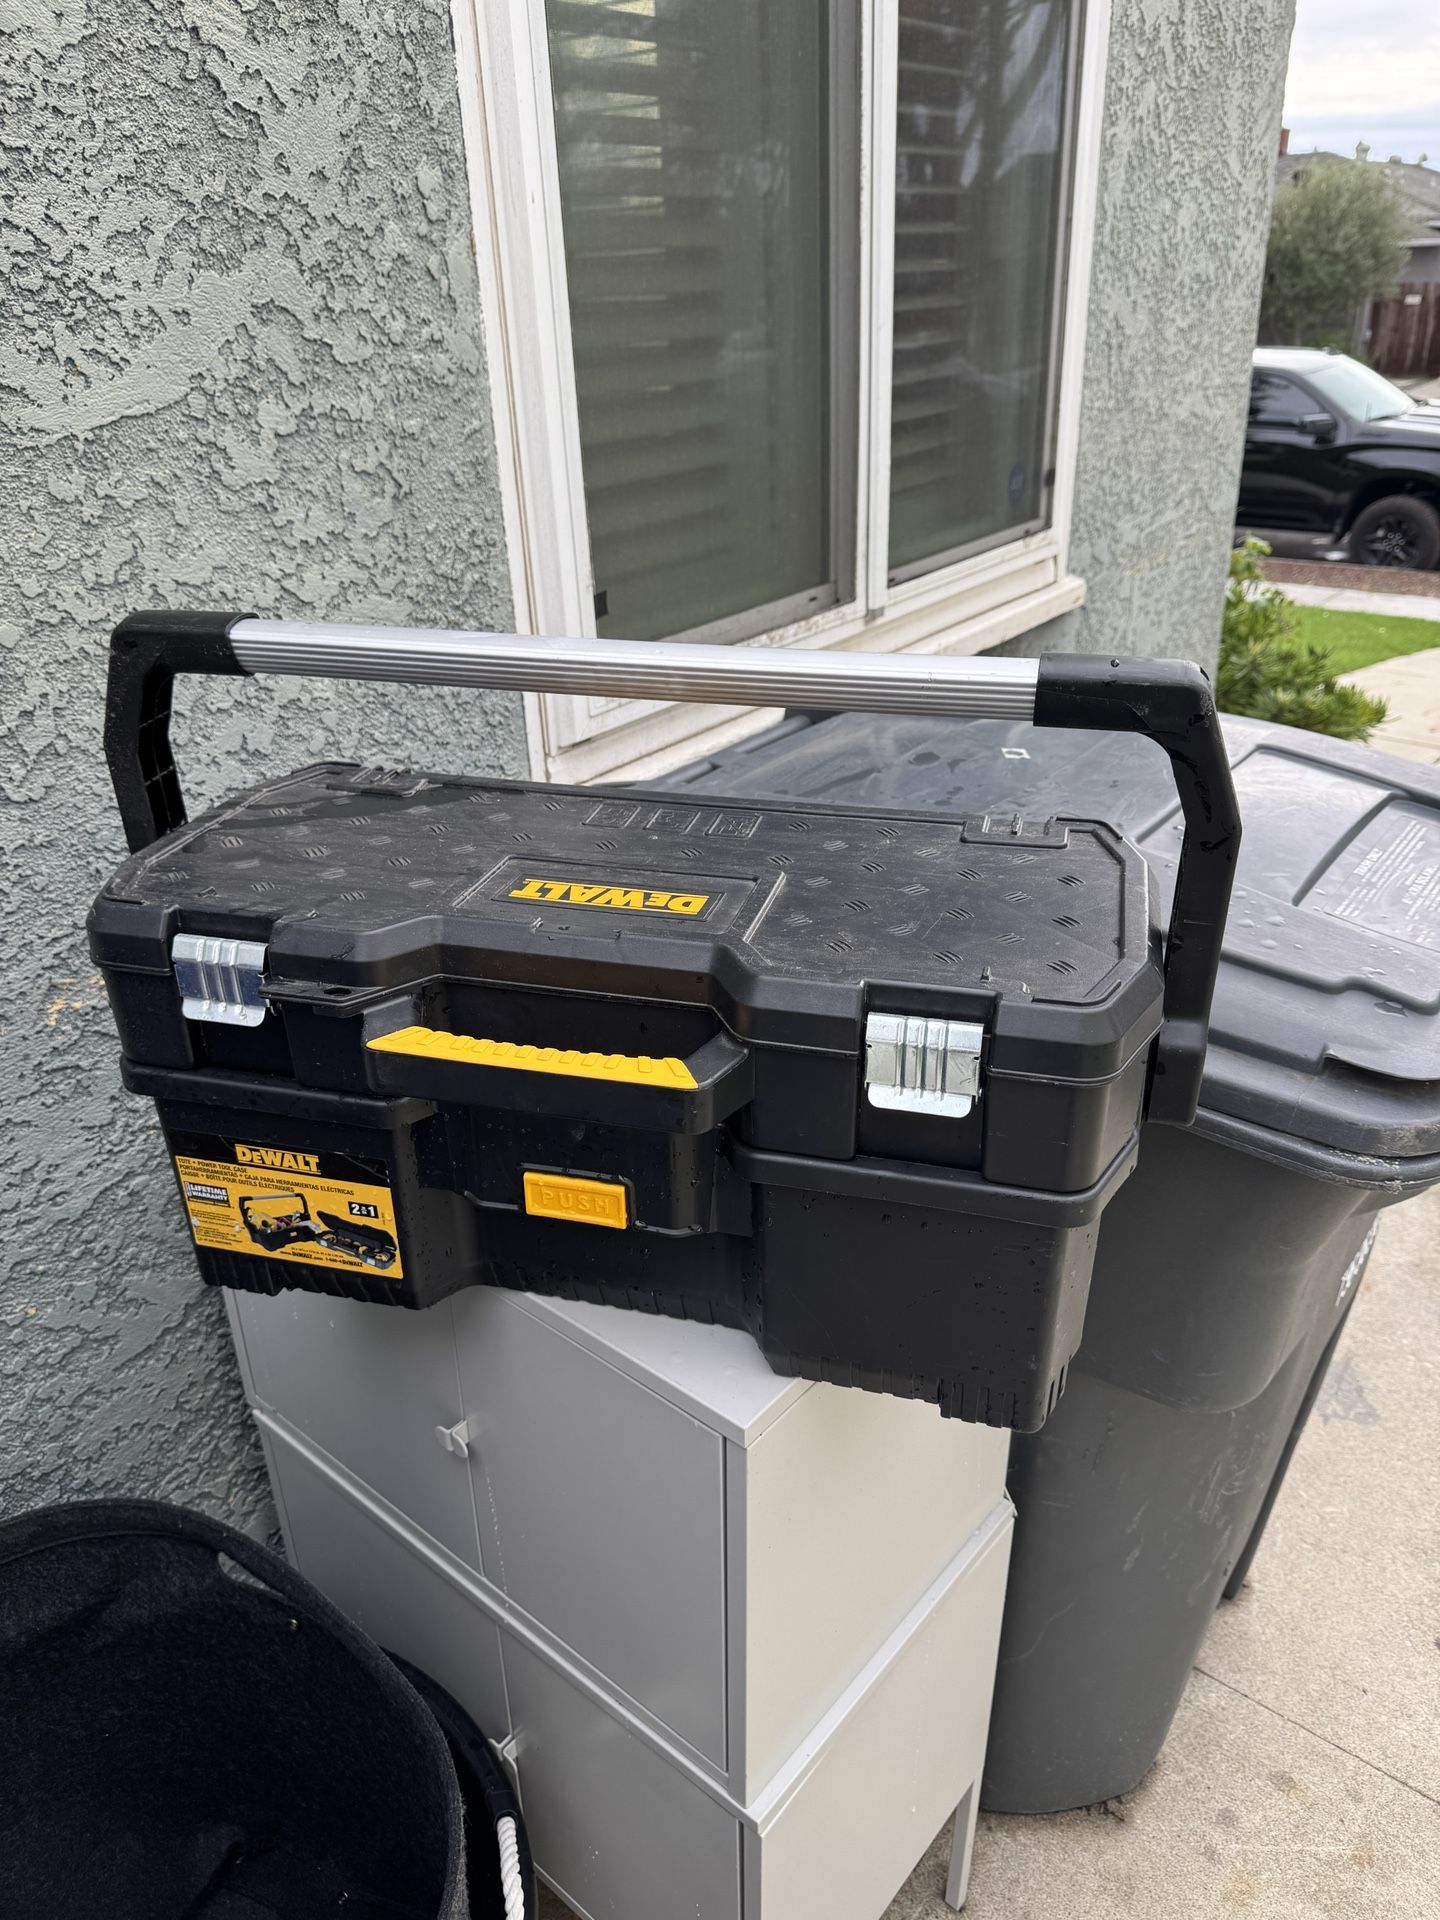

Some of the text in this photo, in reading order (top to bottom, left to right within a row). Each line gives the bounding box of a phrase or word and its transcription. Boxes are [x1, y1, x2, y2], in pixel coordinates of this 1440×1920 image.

[509, 879, 709, 915] DEWALT
[235, 1145, 320, 1173] DEWALT
[234, 1166, 248, 1174] CASE
[222, 1176, 237, 1184] POUR
[260, 1176, 275, 1184] PARA
[190, 1183, 227, 1195] LIFETIME
[191, 1191, 228, 1201] WARRANTY
[540, 1187, 609, 1215] PUSH
